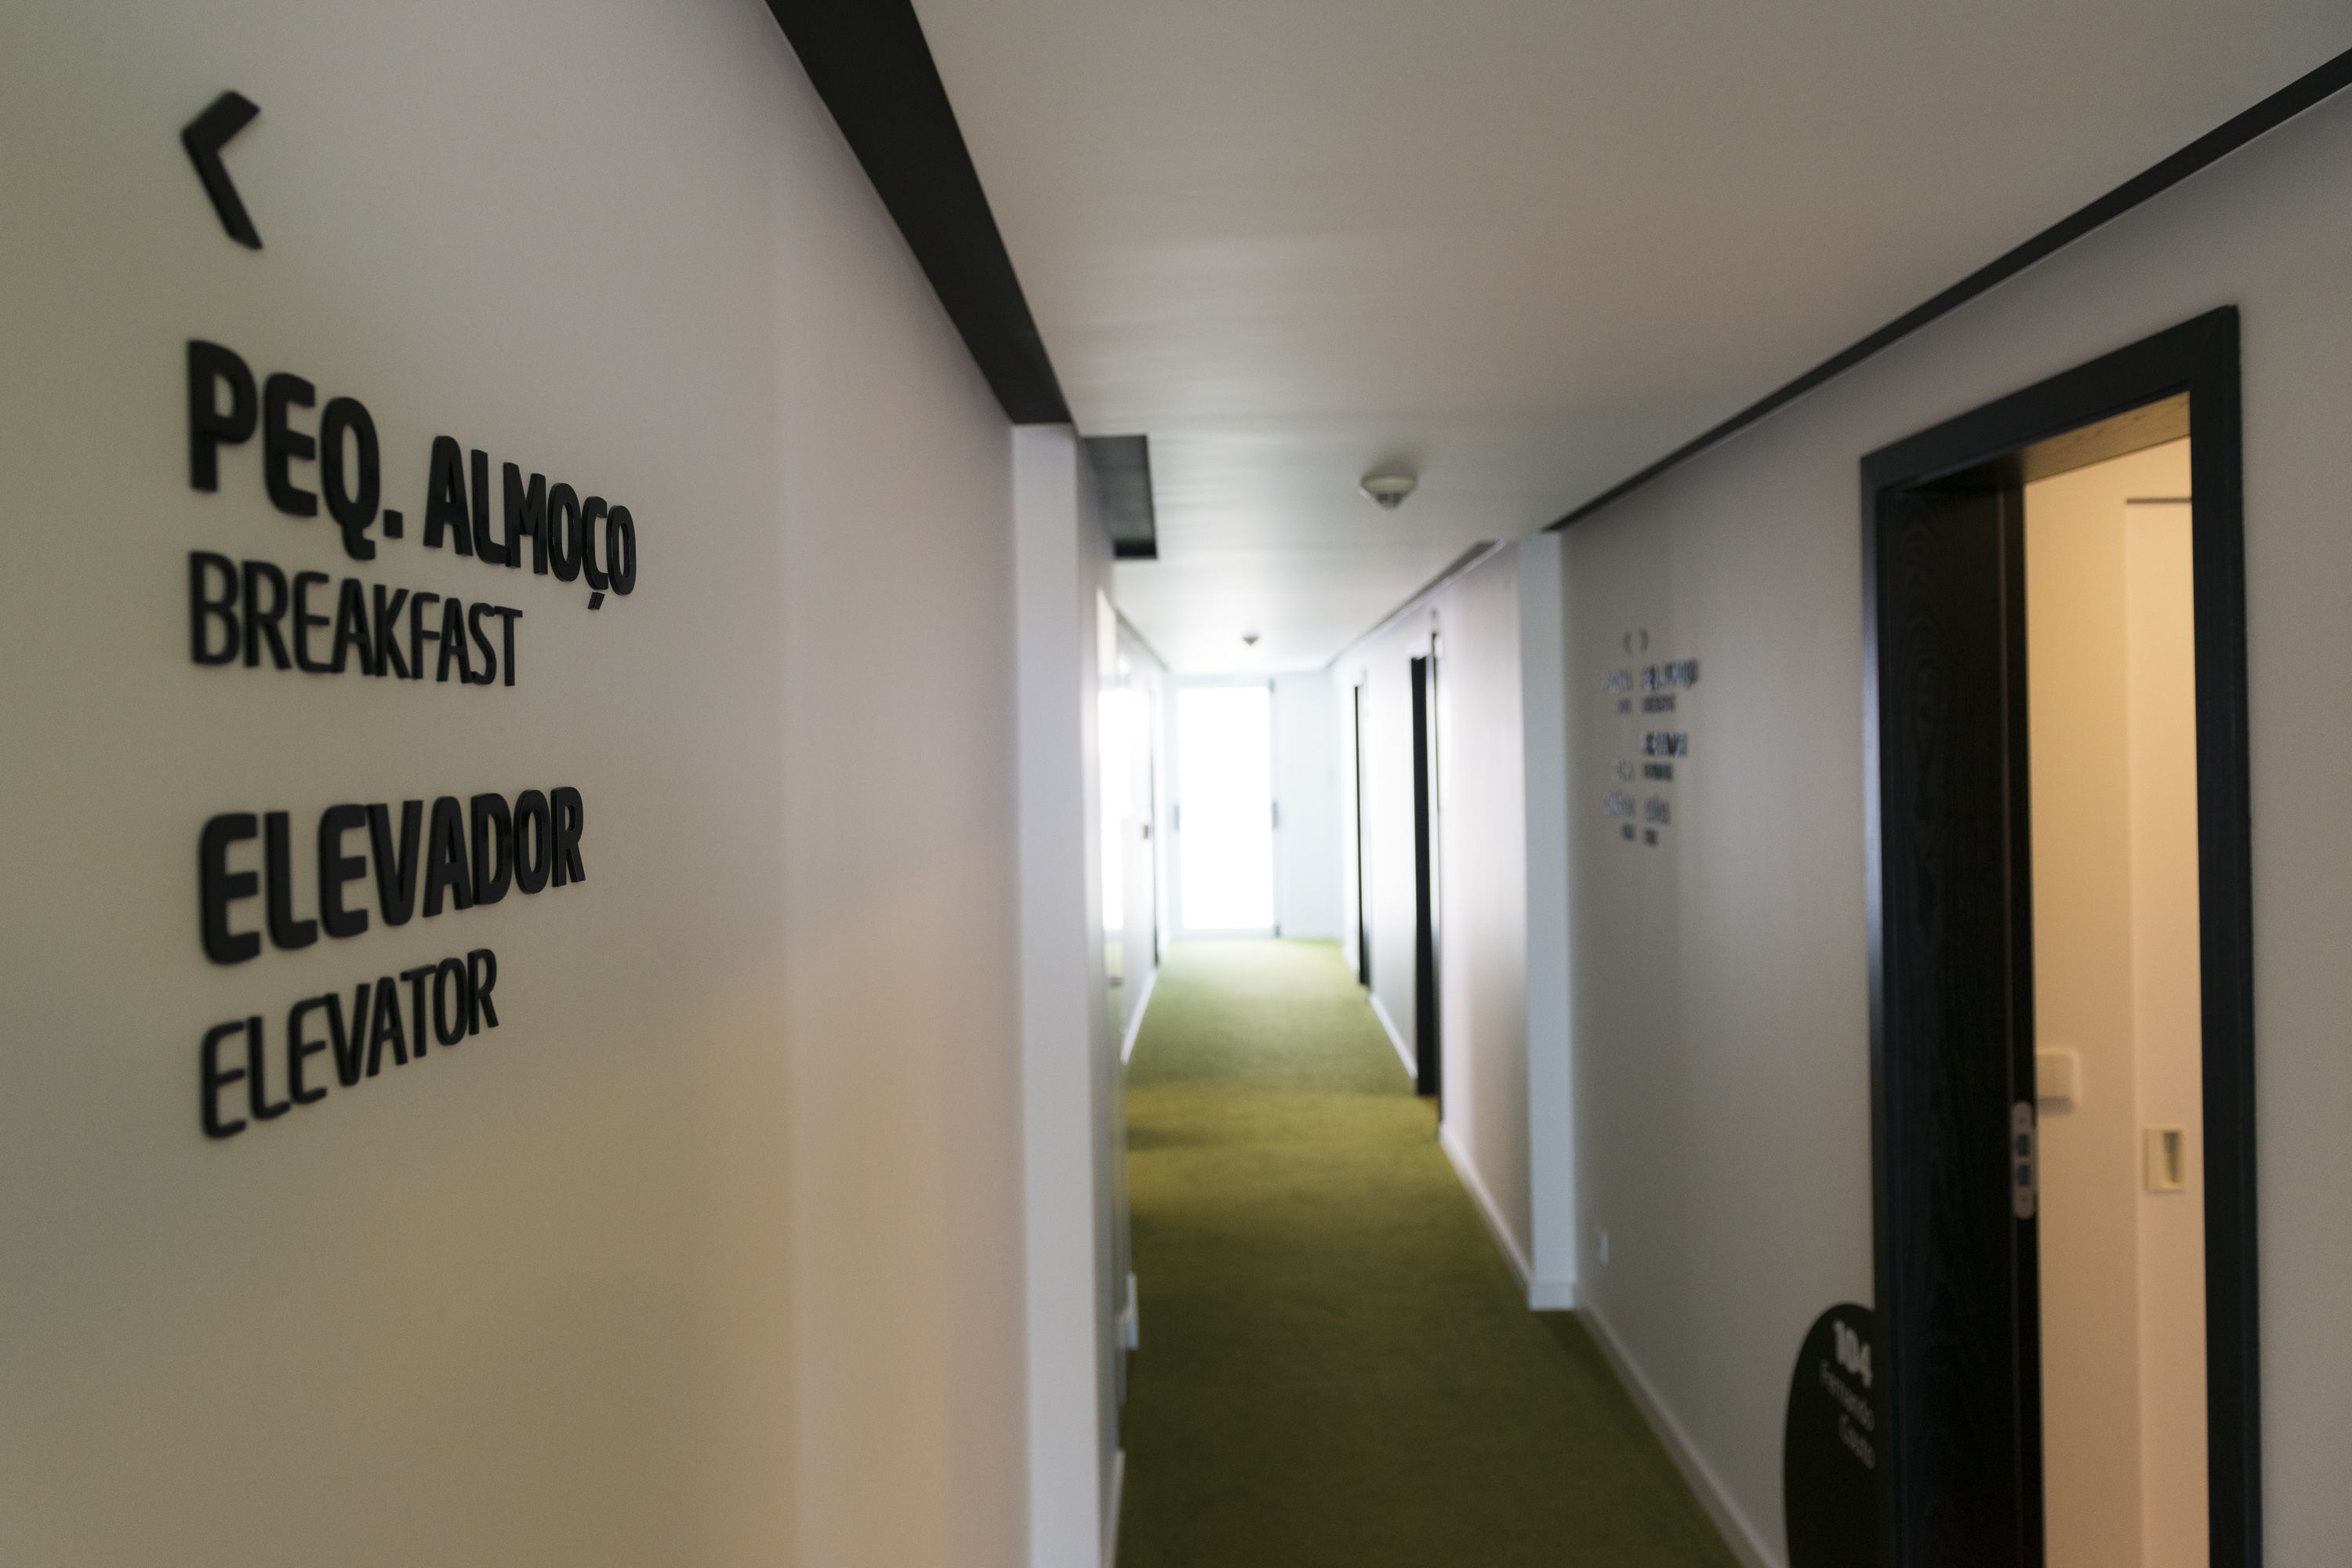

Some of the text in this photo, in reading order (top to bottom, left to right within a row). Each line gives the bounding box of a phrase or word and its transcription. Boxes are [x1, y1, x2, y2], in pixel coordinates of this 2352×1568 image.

[187, 339, 637, 610] PEQ. ALMOÇO
[189, 550, 523, 686] BREAKFAST
[200, 786, 586, 965] ELEVADOR
[201, 949, 499, 1139] ELEVATOR
[1833, 1319, 1873, 1388] 104
